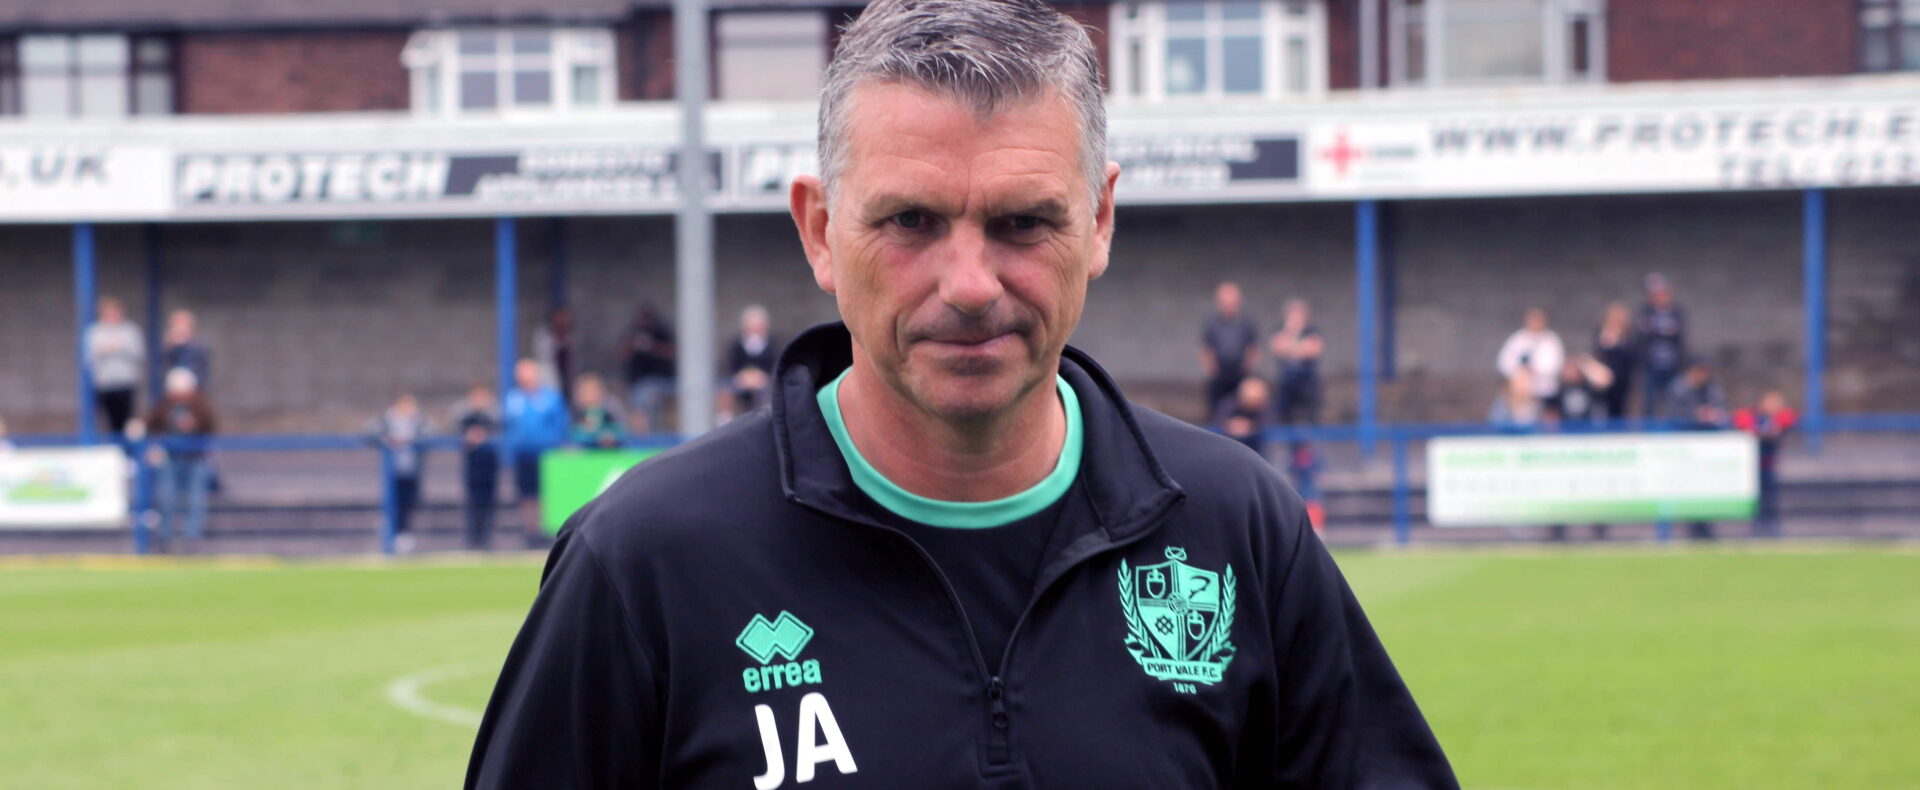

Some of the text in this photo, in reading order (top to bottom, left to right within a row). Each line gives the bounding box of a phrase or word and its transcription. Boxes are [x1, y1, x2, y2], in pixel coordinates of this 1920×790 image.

[0, 149, 108, 183] .UK
[178, 154, 449, 201] PROTECH
[742, 658, 822, 693] errea
[1147, 663, 1218, 678] PORT VALE F.C.
[753, 692, 858, 790] JA
